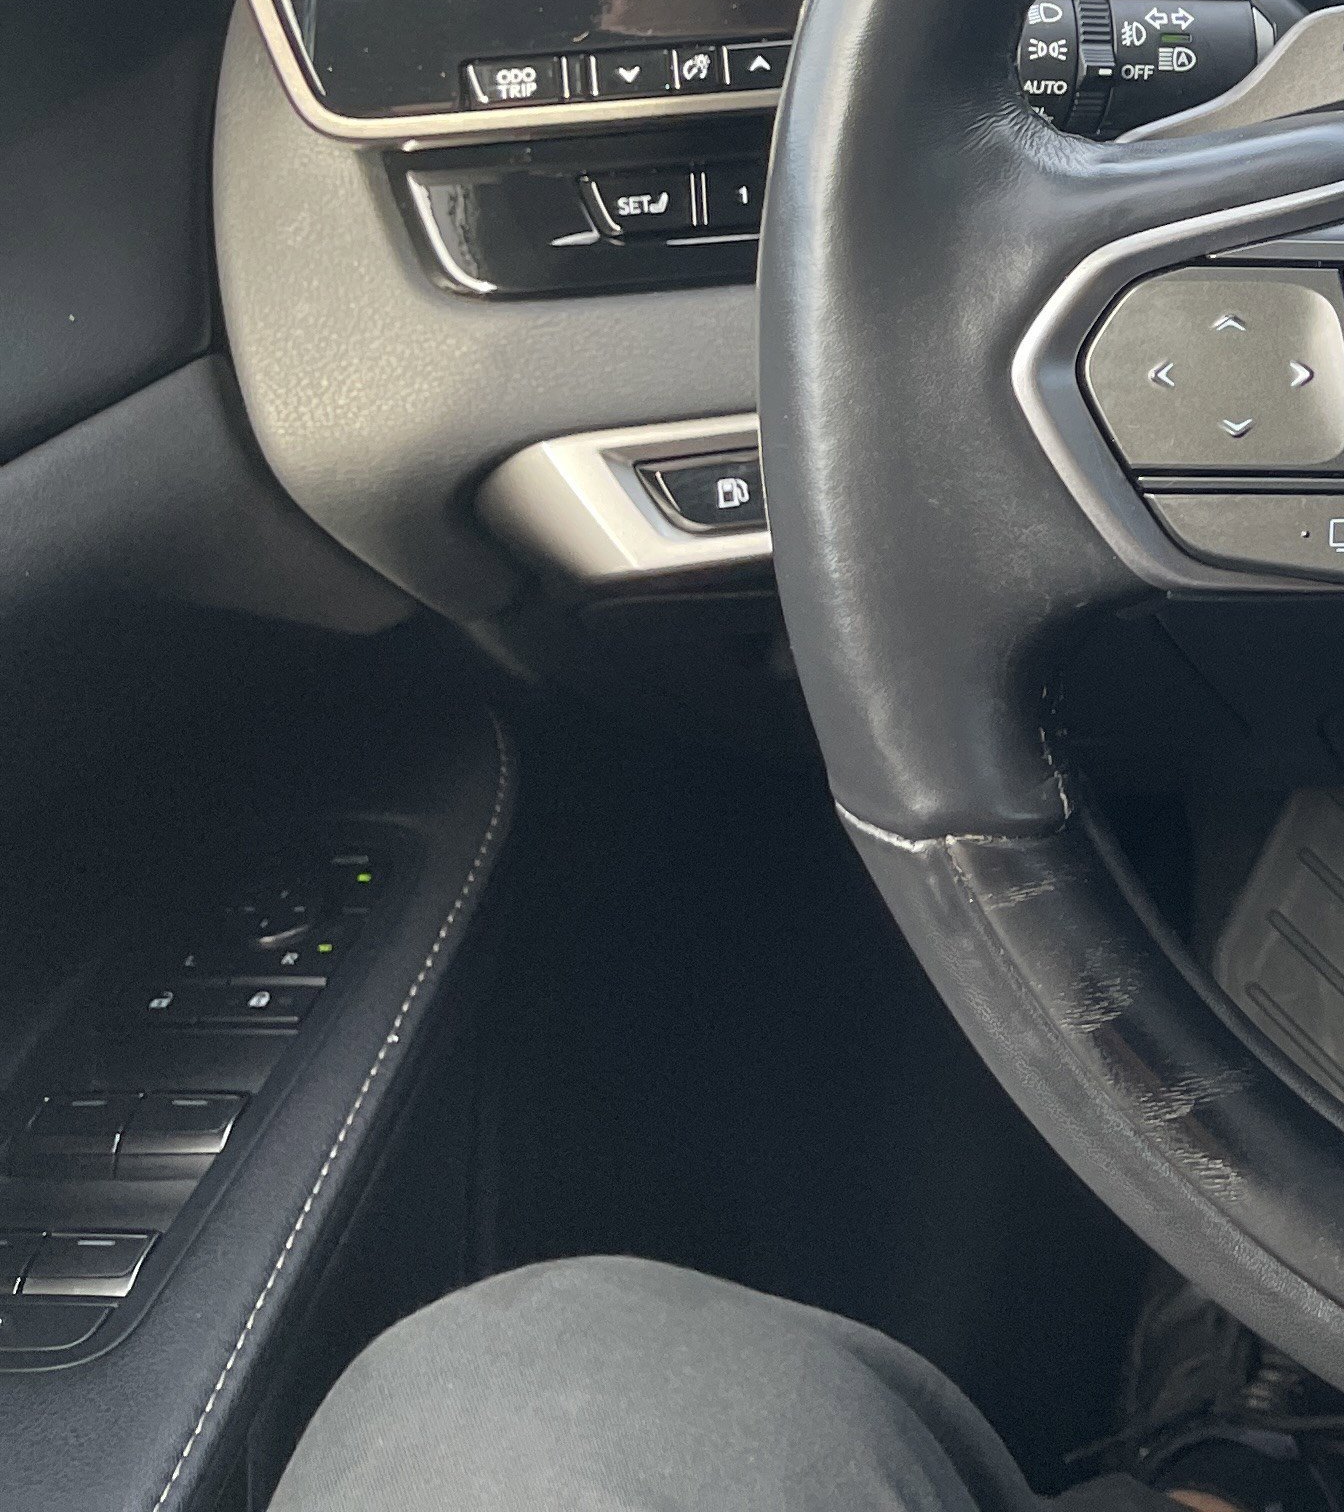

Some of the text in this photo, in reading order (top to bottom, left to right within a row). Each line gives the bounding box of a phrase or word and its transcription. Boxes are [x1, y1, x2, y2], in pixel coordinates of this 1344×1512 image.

[497, 67, 536, 84] ODO
[1121, 63, 1155, 81] OFF
[498, 83, 537, 99] TRIP
[1023, 80, 1068, 94] AUTO
[738, 185, 749, 205] 1
[617, 194, 652, 216] SET
